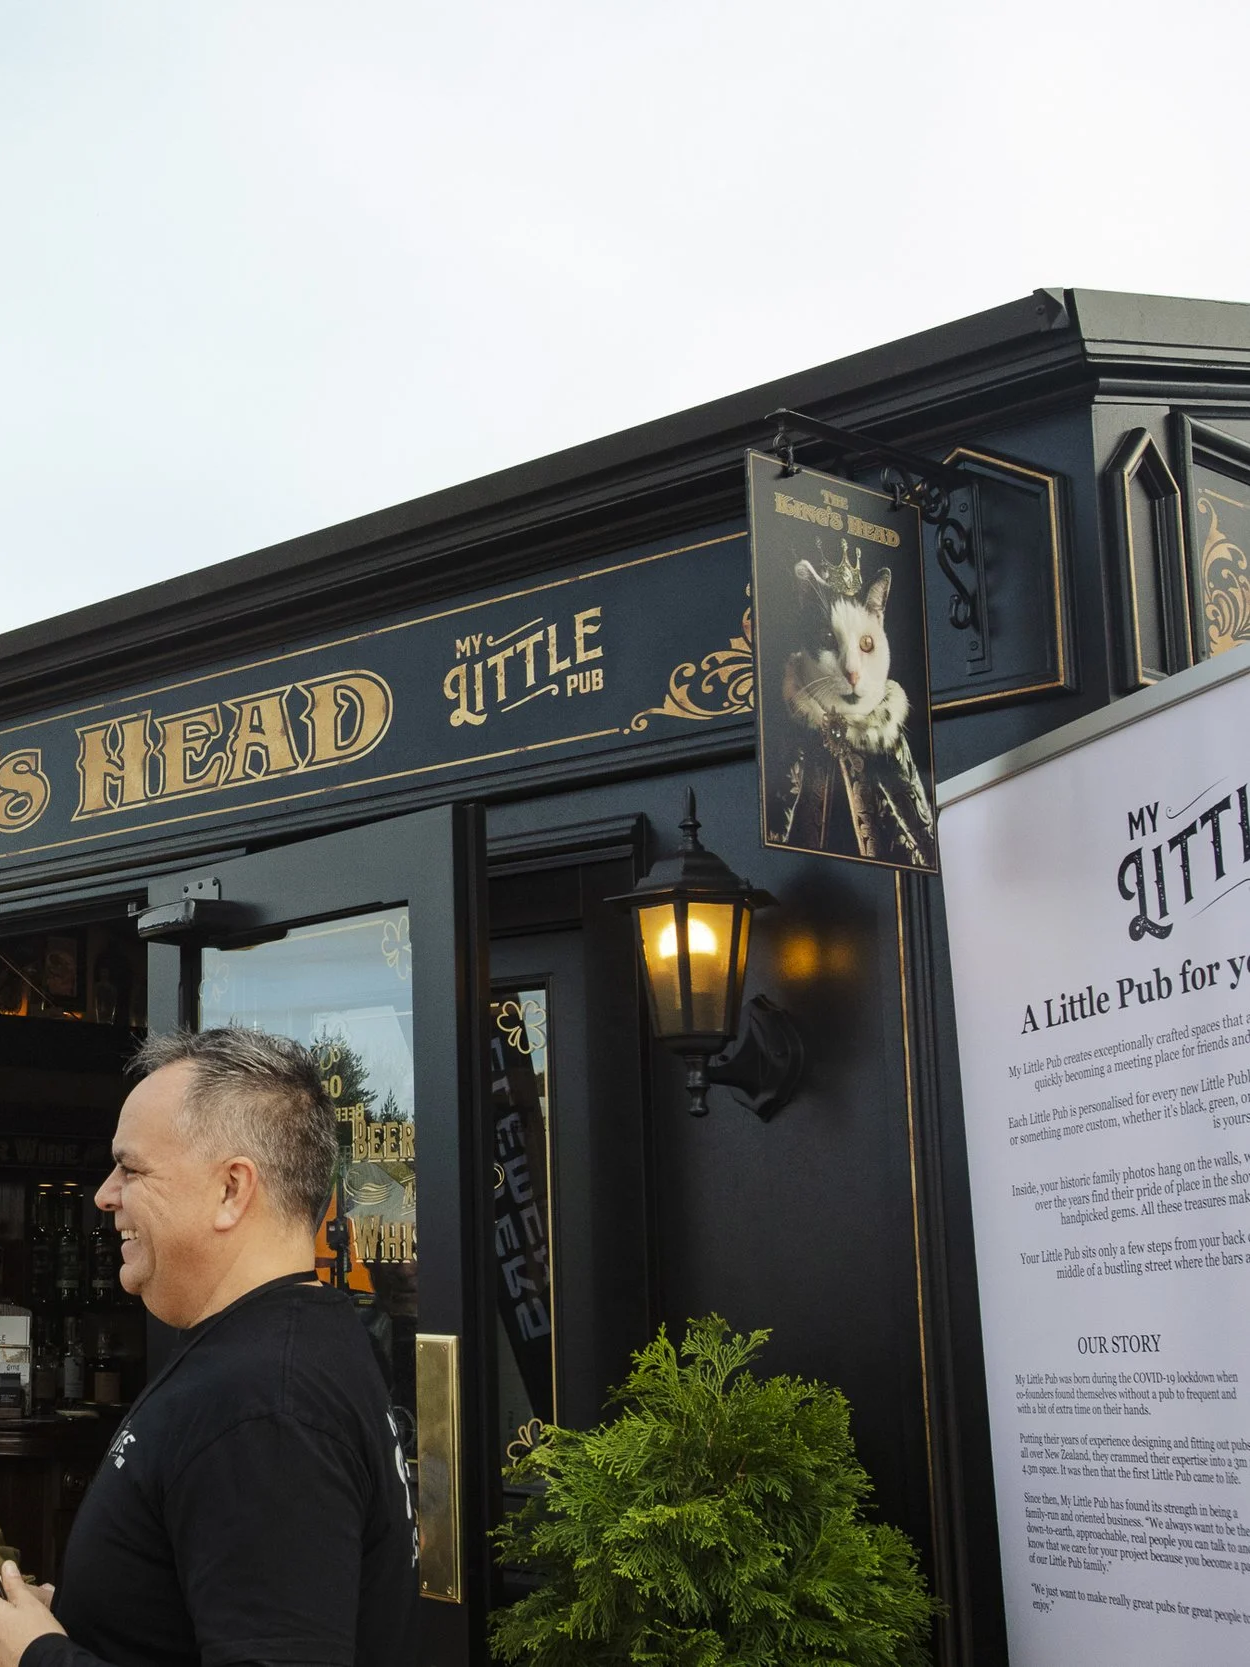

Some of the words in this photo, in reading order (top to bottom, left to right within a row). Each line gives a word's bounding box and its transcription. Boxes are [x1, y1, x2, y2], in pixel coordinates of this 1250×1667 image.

[455, 632, 484, 659] MY
[443, 605, 604, 728] LITTLE
[566, 668, 604, 699] PUB
[72, 668, 393, 823] HEAD
[1127, 802, 1160, 840] MY
[1021, 1004, 1040, 1034] A
[1045, 985, 1110, 1028] Little
[1116, 968, 1172, 1009] Pub
[1179, 959, 1220, 994] for
[1008, 1066, 1021, 1080] My
[1023, 1060, 1044, 1075] Little
[1046, 1055, 1062, 1069] Pub
[1063, 1049, 1092, 1065] creates
[1094, 1034, 1153, 1058] exceptionally
[1156, 1025, 1189, 1045] crafted
[1191, 1021, 1220, 1040] spaces
[1223, 1012, 1243, 1030] that
[1034, 1073, 1063, 1092] quickly
[1065, 1066, 1105, 1083] becoming
[1107, 1065, 1112, 1074] a
[1114, 1055, 1153, 1072] meeting
[1154, 1049, 1179, 1068] place
[1182, 1044, 1195, 1058] for
[1197, 1034, 1229, 1054] friends
[1008, 1114, 1028, 1129] Each
[1029, 1110, 1051, 1125] Little
[1052, 1106, 1068, 1120] Pub
[1069, 1106, 1077, 1117] is
[1078, 1093, 1134, 1119] personalised
[1136, 1092, 1150, 1105] for
[1152, 1088, 1179, 1102] every
[1180, 1084, 1199, 1096] new
[1201, 1075, 1225, 1092] Little
[1009, 1137, 1018, 1146] or
[1020, 1128, 1062, 1144] something
[1063, 1125, 1084, 1136] more
[1086, 1117, 1120, 1132] custom,
[1122, 1108, 1162, 1125] whether
[1163, 1104, 1179, 1118] it's
[1180, 1099, 1206, 1116] black,
[1209, 1097, 1238, 1114] green,
[1012, 1182, 1039, 1197] Inside,
[1040, 1181, 1059, 1196] your
[1060, 1174, 1091, 1190] historic
[1092, 1168, 1121, 1186] family
[1123, 1164, 1155, 1185] photos
[1157, 1161, 1182, 1178] hang
[1184, 1161, 1195, 1172] on
[1197, 1155, 1212, 1171] the
[1213, 1151, 1242, 1168] walls,
[1060, 1207, 1109, 1227] handpicked
[1111, 1208, 1138, 1223] gems.
[1140, 1201, 1154, 1216] All
[1157, 1200, 1182, 1214] these
[1184, 1196, 1227, 1211] treasures
[1020, 1253, 1039, 1265] Your
[1041, 1249, 1062, 1263] Little
[1064, 1247, 1080, 1261] Pub
[1081, 1245, 1096, 1259] sits
[1098, 1243, 1119, 1260] only
[1120, 1246, 1125, 1256] a
[1128, 1242, 1145, 1255] few
[1147, 1239, 1172, 1256] steps
[1174, 1237, 1197, 1250] from
[1199, 1236, 1220, 1252] your
[1222, 1229, 1245, 1245] back
[1056, 1265, 1085, 1279] middle
[1087, 1264, 1097, 1277] of
[1097, 1267, 1102, 1276] a
[1104, 1260, 1143, 1276] bustling
[1145, 1256, 1172, 1272] street
[1174, 1255, 1204, 1270] where
[1205, 1253, 1220, 1267] the
[1222, 1252, 1243, 1266] bars
[1078, 1336, 1109, 1354] OUR
[1112, 1334, 1161, 1353] STORY
[1015, 1374, 1026, 1388] My
[1026, 1373, 1044, 1385] Little
[1045, 1373, 1059, 1384] Pub
[1059, 1376, 1072, 1384] was
[1073, 1373, 1091, 1384] born
[1092, 1372, 1117, 1387] during
[1118, 1372, 1132, 1384] the
[1133, 1371, 1175, 1384] COVID-19
[1177, 1371, 1215, 1383] lockdown
[1216, 1371, 1238, 1383] when
[1016, 1388, 1054, 1400] co-founders
[1054, 1388, 1075, 1400] found
[1076, 1388, 1117, 1400] themselves
[1118, 1388, 1150, 1400] without
[1151, 1391, 1157, 1400] a
[1158, 1388, 1175, 1403] pub
[1176, 1388, 1185, 1400] to
[1186, 1388, 1220, 1403] frequent
[1221, 1388, 1237, 1400] and
[1024, 1492, 1041, 1504] Since
[1042, 1493, 1060, 1507] then,
[1060, 1495, 1072, 1509] My
[1073, 1496, 1092, 1508] Little
[1093, 1497, 1109, 1509] Pub
[1110, 1498, 1124, 1510] has
[1125, 1499, 1150, 1512] found
[1151, 1501, 1162, 1513] its
[1164, 1502, 1198, 1519] strength
[1199, 1505, 1208, 1517] in
[1209, 1504, 1231, 1522] being
[1233, 1509, 1238, 1518] a
